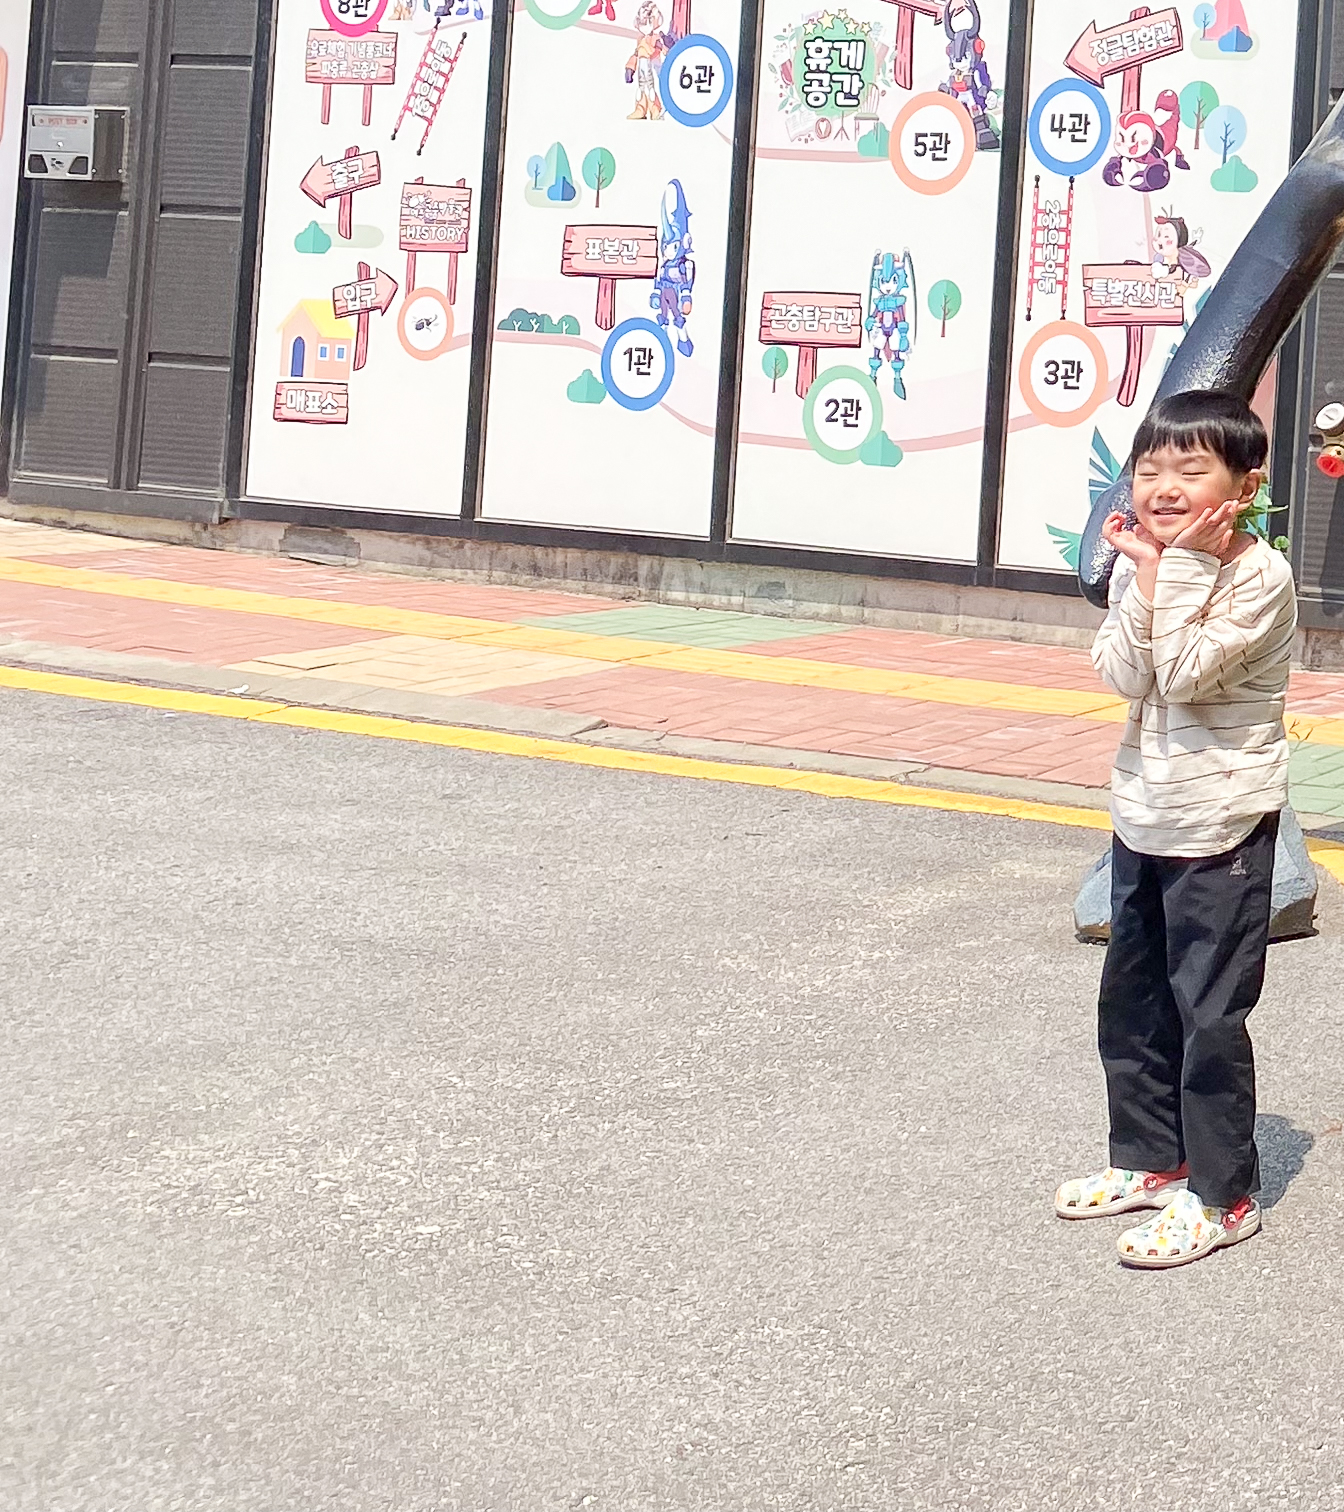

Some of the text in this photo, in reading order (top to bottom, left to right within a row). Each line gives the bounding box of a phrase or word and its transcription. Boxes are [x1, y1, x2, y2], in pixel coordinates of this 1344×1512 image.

[804, 36, 866, 72] 휴게
[1089, 22, 1176, 66] 정글탐험관
[679, 65, 715, 93] 6관
[802, 72, 864, 108] 공간
[1050, 113, 1091, 143] 4관
[913, 132, 951, 161] 5관
[331, 158, 364, 190] 출구
[406, 225, 465, 241] HISTORY
[1037, 199, 1062, 295] 2층으로이동
[585, 238, 640, 265] 표본관
[342, 282, 377, 310] 입구
[1091, 278, 1177, 308] 특별전시관
[769, 303, 854, 333] 곤충탐구관
[623, 347, 653, 376] 1관
[1043, 360, 1083, 390] 3관
[286, 389, 339, 415] 매표소
[825, 398, 862, 428] 2관
